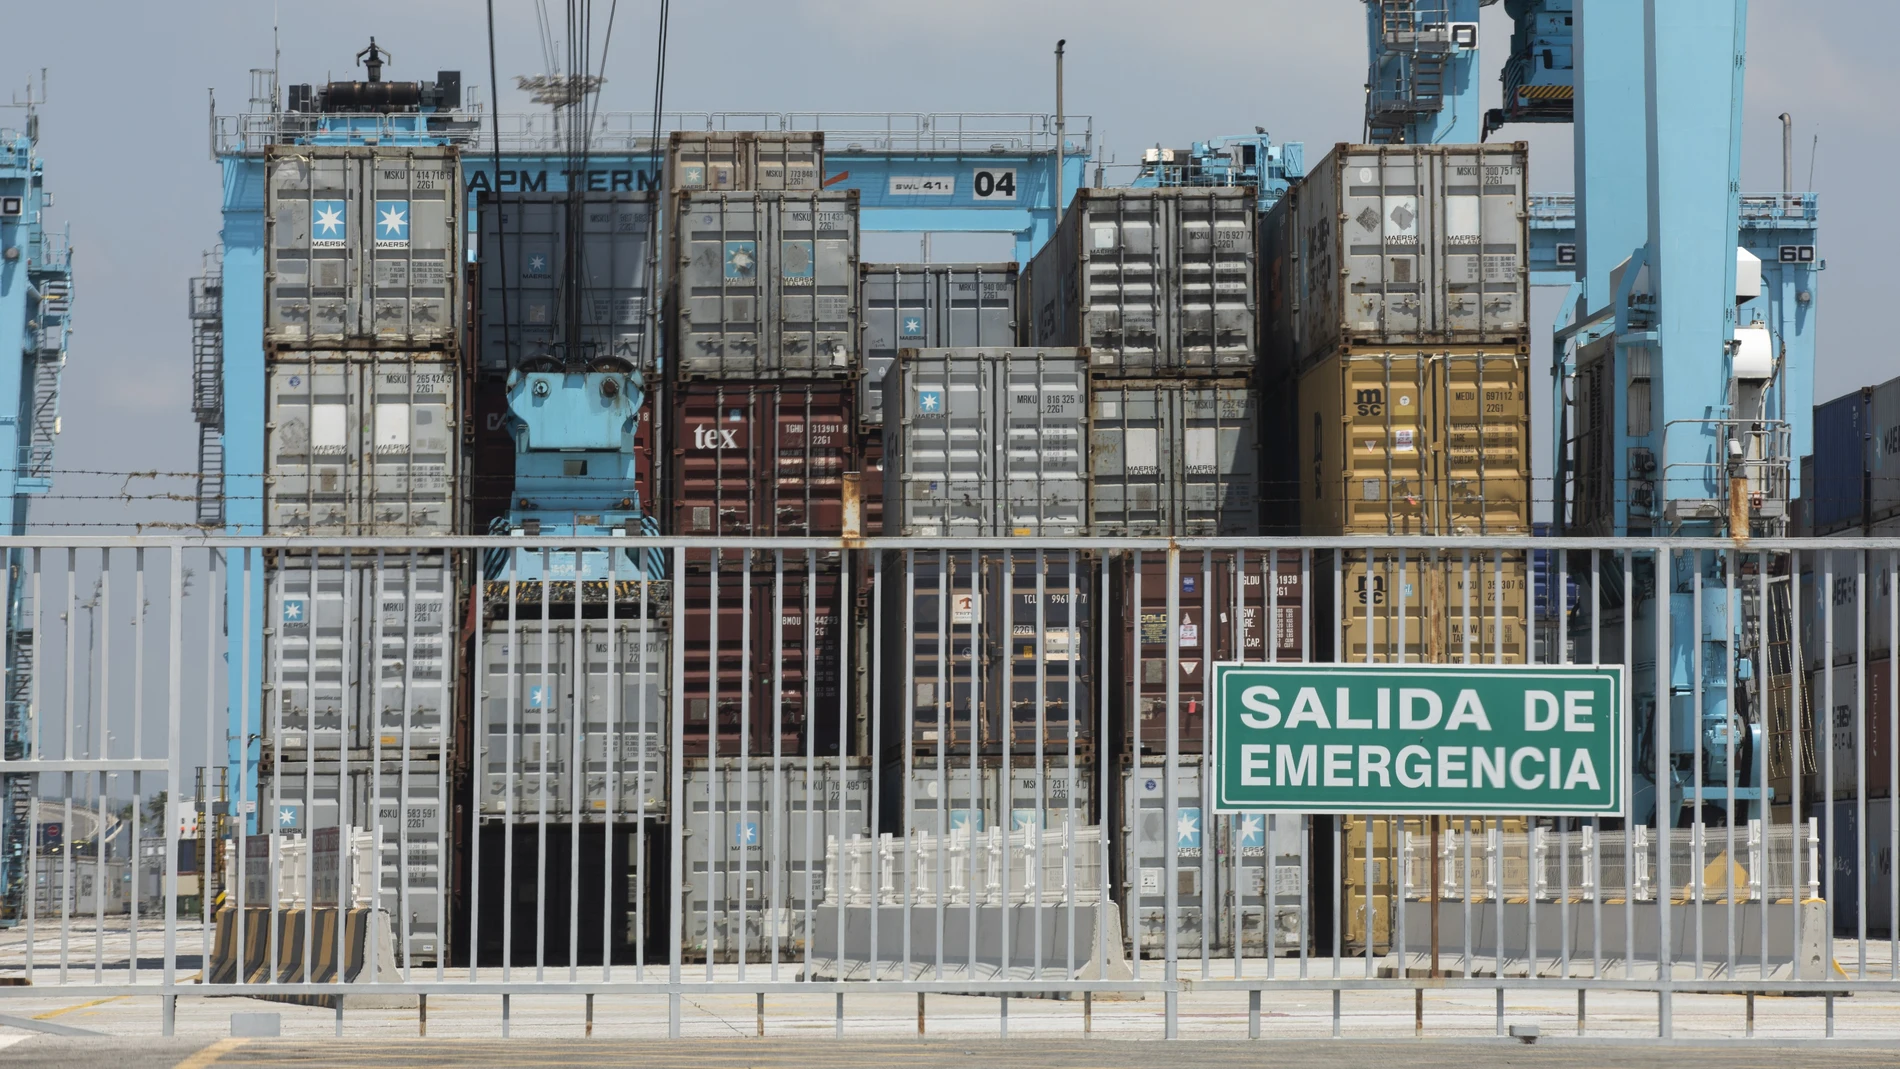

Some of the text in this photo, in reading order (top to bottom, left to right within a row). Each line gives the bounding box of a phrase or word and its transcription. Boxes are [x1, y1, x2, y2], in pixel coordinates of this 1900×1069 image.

[384, 171, 405, 179] MSKU
[416, 171, 429, 180] 414
[433, 171, 445, 180] 716
[766, 170, 783, 178] MSKU
[790, 170, 802, 178] 773
[1457, 166, 1521, 176] MSKU 300 751 3
[417, 180, 434, 189] 22G1
[467, 170, 547, 192] APM
[974, 171, 1016, 197] 04
[1485, 176, 1503, 184] 22G1
[923, 182, 942, 190] 41
[793, 213, 811, 221] MSKU
[819, 213, 832, 221] 211
[819, 222, 835, 230] 22G1
[1190, 231, 1210, 240] MSKU
[1218, 231, 1231, 240] 716
[1232, 231, 1244, 240] 927
[1218, 240, 1234, 248] 22G1
[1780, 246, 1814, 261] 60
[386, 375, 452, 384] MSKU 265 424 3
[416, 384, 434, 393] 22G1
[1017, 395, 1084, 404] MRKU 816 325 0
[1456, 392, 1474, 401] MEDU
[1486, 391, 1513, 401] 697112
[1047, 405, 1064, 413] 22G1
[1194, 401, 1213, 410] MSKU
[1486, 403, 1504, 413] 22G1
[1222, 410, 1239, 418] 22G1
[786, 424, 804, 433] TGHU
[812, 424, 839, 433] 313901
[693, 423, 738, 450] tex
[813, 435, 831, 445] 22G1
[1457, 580, 1477, 589] MCU
[1024, 595, 1036, 604] TCL
[1487, 592, 1506, 601] 221
[382, 603, 404, 612] MRKU
[782, 616, 801, 626] BMOU
[1013, 625, 1034, 634] 22G1
[595, 644, 616, 652] MSU
[1240, 685, 1595, 732] SALIDA DE
[1240, 743, 1601, 790] EMERGENCIA
[802, 781, 823, 790] MKU
[831, 781, 840, 790] 76
[831, 791, 848, 800] 221
[407, 809, 421, 818] 583
[422, 809, 436, 818] 591
[407, 819, 425, 828] 22G1
